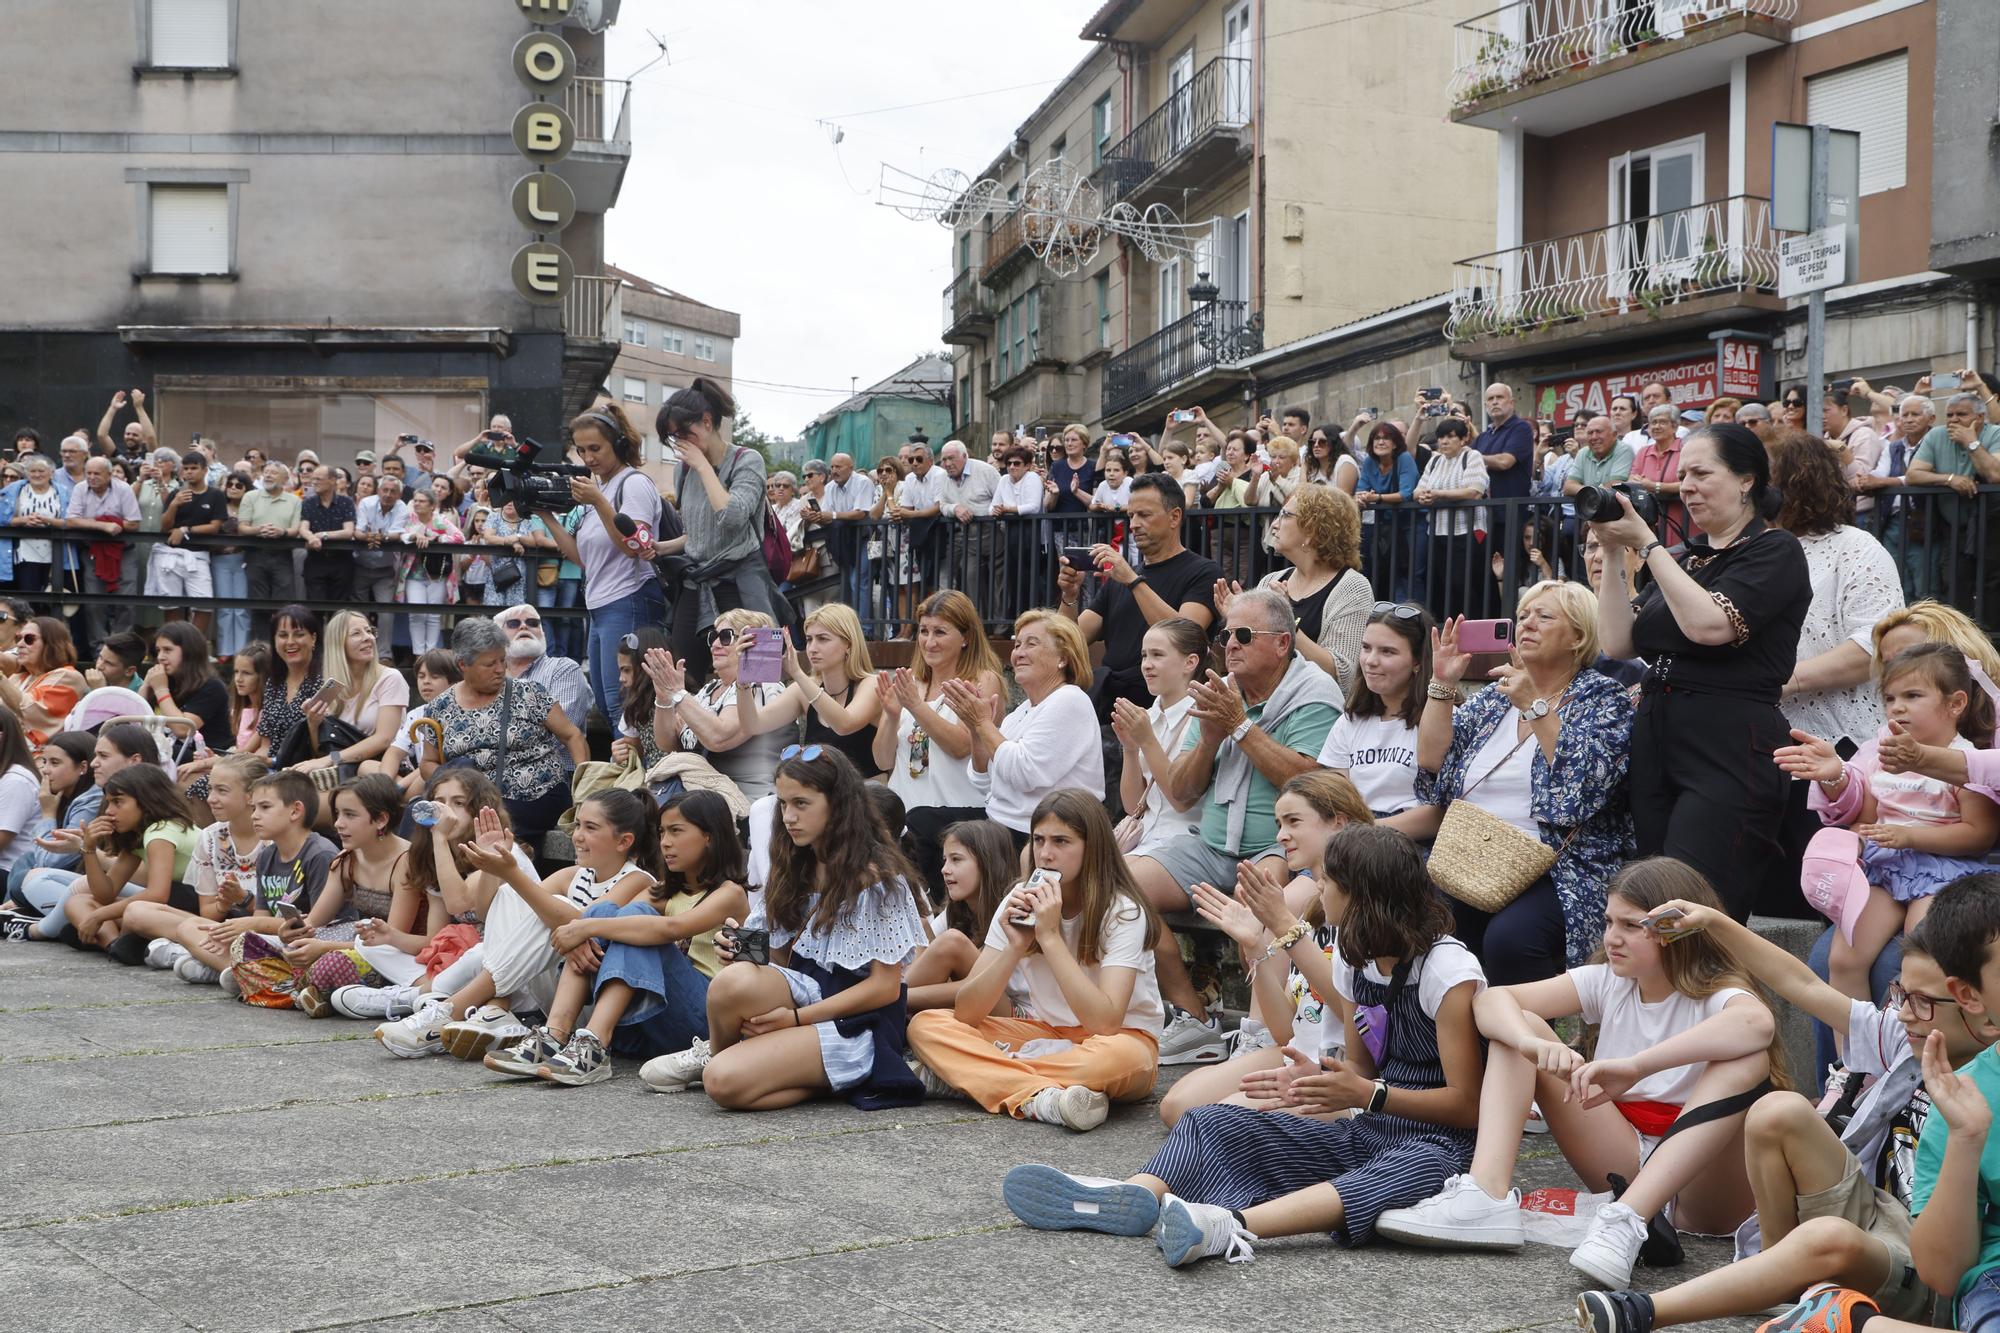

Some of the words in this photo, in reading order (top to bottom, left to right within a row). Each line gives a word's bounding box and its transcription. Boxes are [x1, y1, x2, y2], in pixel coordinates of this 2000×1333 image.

[1808, 260, 1827, 273] PESCA
[1724, 343, 1758, 370] SAT
[1564, 376, 1627, 421] SAT
